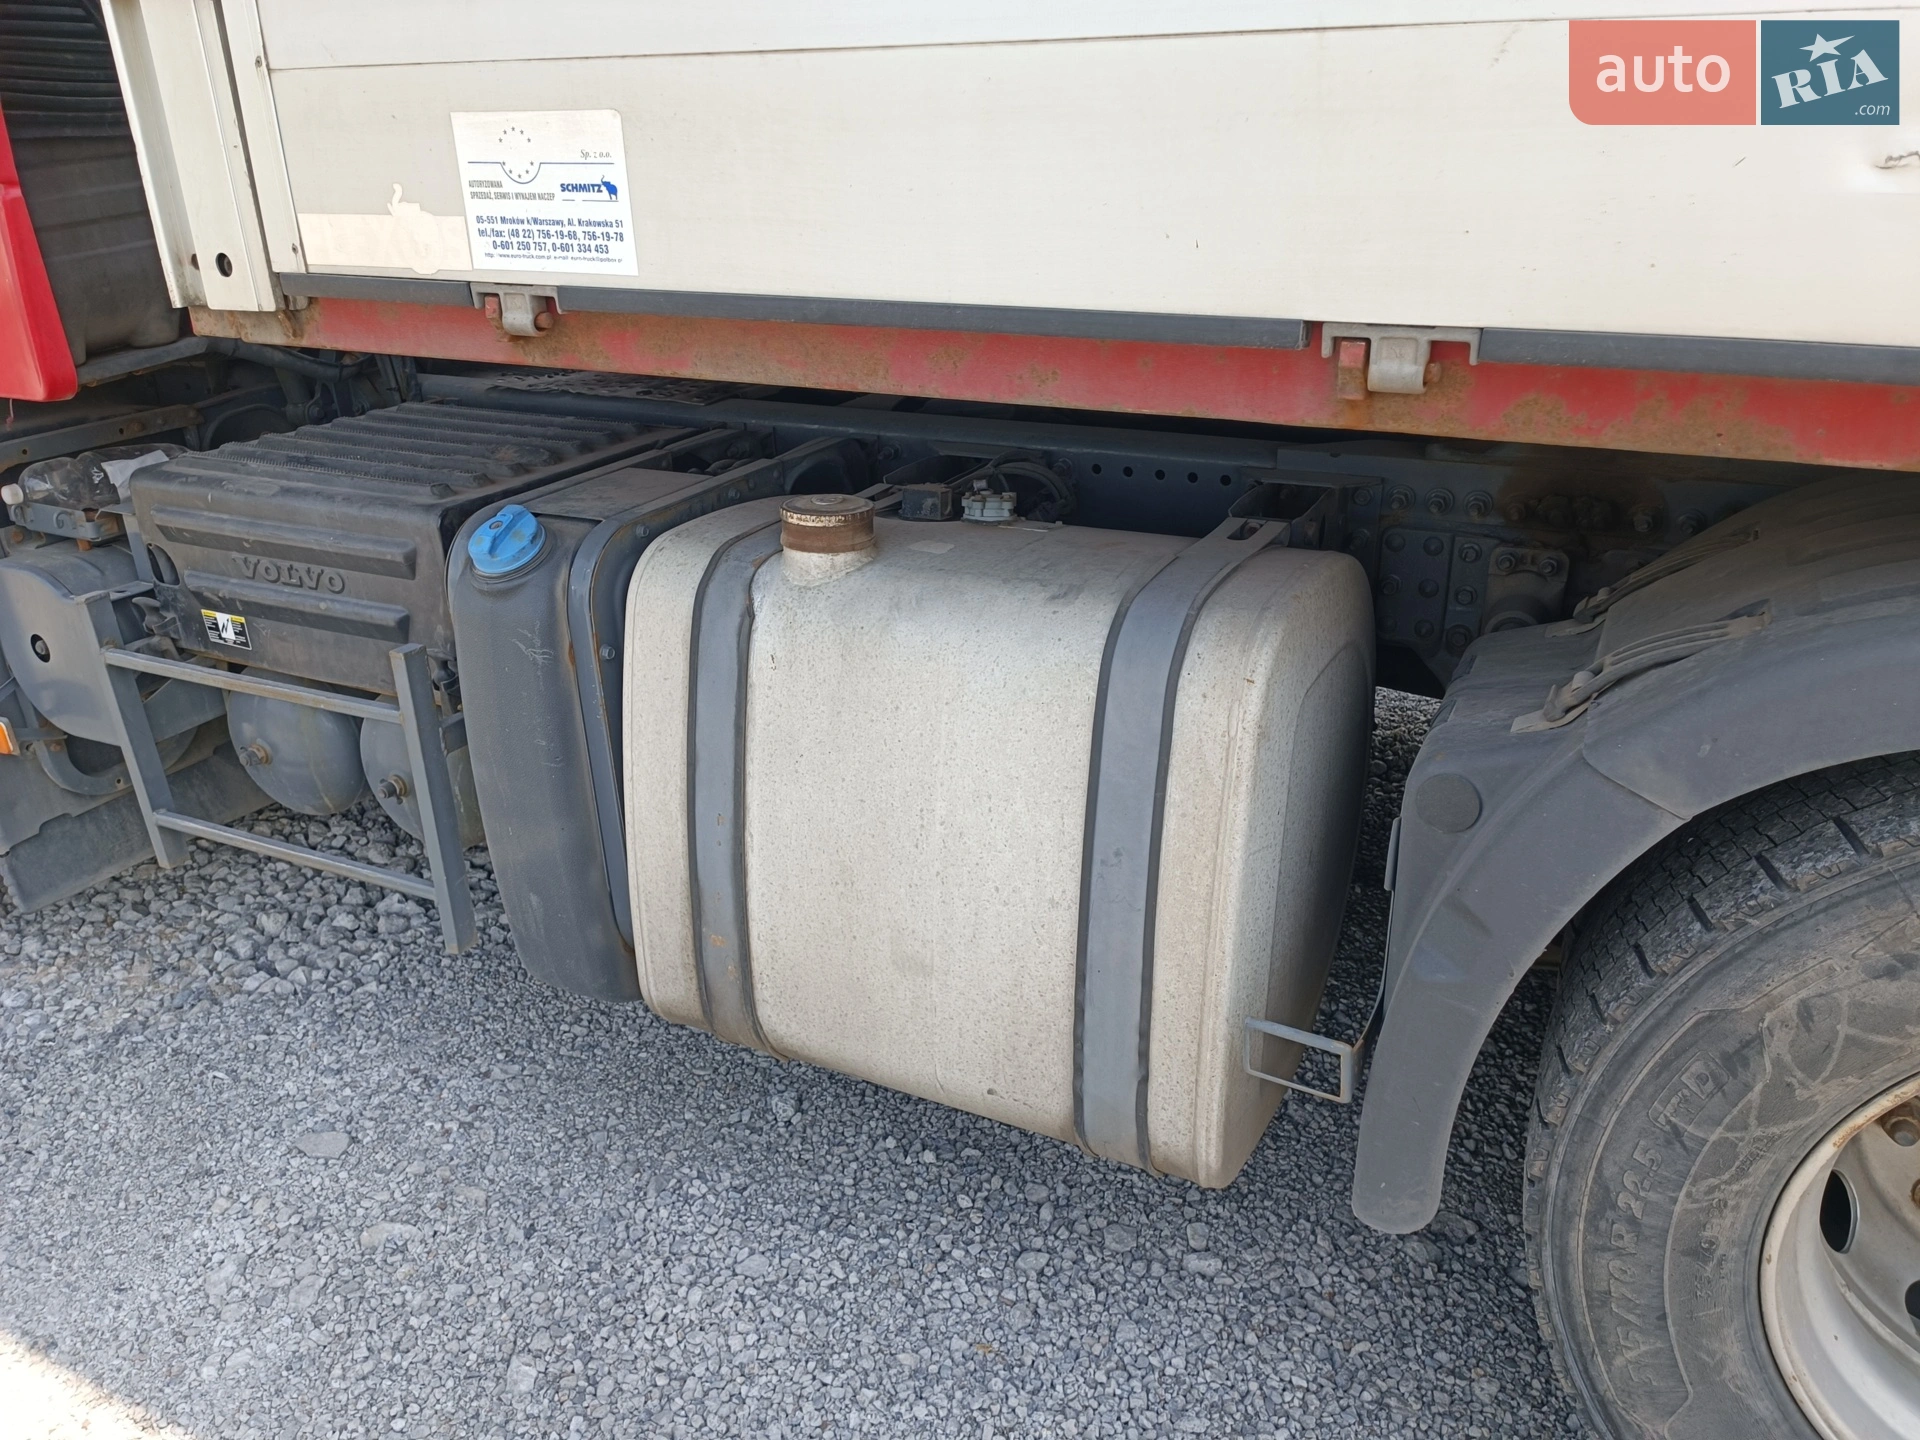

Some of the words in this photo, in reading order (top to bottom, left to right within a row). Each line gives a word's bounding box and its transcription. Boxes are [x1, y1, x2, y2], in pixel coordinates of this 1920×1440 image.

[580, 149, 592, 160] Sp.
[468, 180, 503, 189] AUTORYZOWANA
[560, 183, 603, 193] SCHMITZ
[494, 192, 512, 200] SERWIS
[514, 192, 537, 200] WYNAJEM
[538, 192, 555, 201] NACZEP
[476, 215, 498, 224] 05-551
[500, 216, 525, 225] Mroków
[526, 216, 566, 228] k/Warszawy,
[568, 217, 576, 227] Al.
[578, 218, 613, 228] Krakowska
[615, 219, 623, 228] 51
[478, 227, 506, 238] tel./fax:
[508, 228, 520, 240] (48
[522, 228, 535, 241] 22)
[536, 229, 580, 242] 756-19-68,
[582, 230, 624, 242] 756-19-78
[492, 240, 514, 250] 0-601
[516, 240, 531, 251] 250
[533, 241, 551, 253] 757,
[552, 242, 574, 253] 0-601
[577, 243, 592, 253] 334
[594, 244, 609, 254] 453
[232, 555, 345, 595] VOLVO
